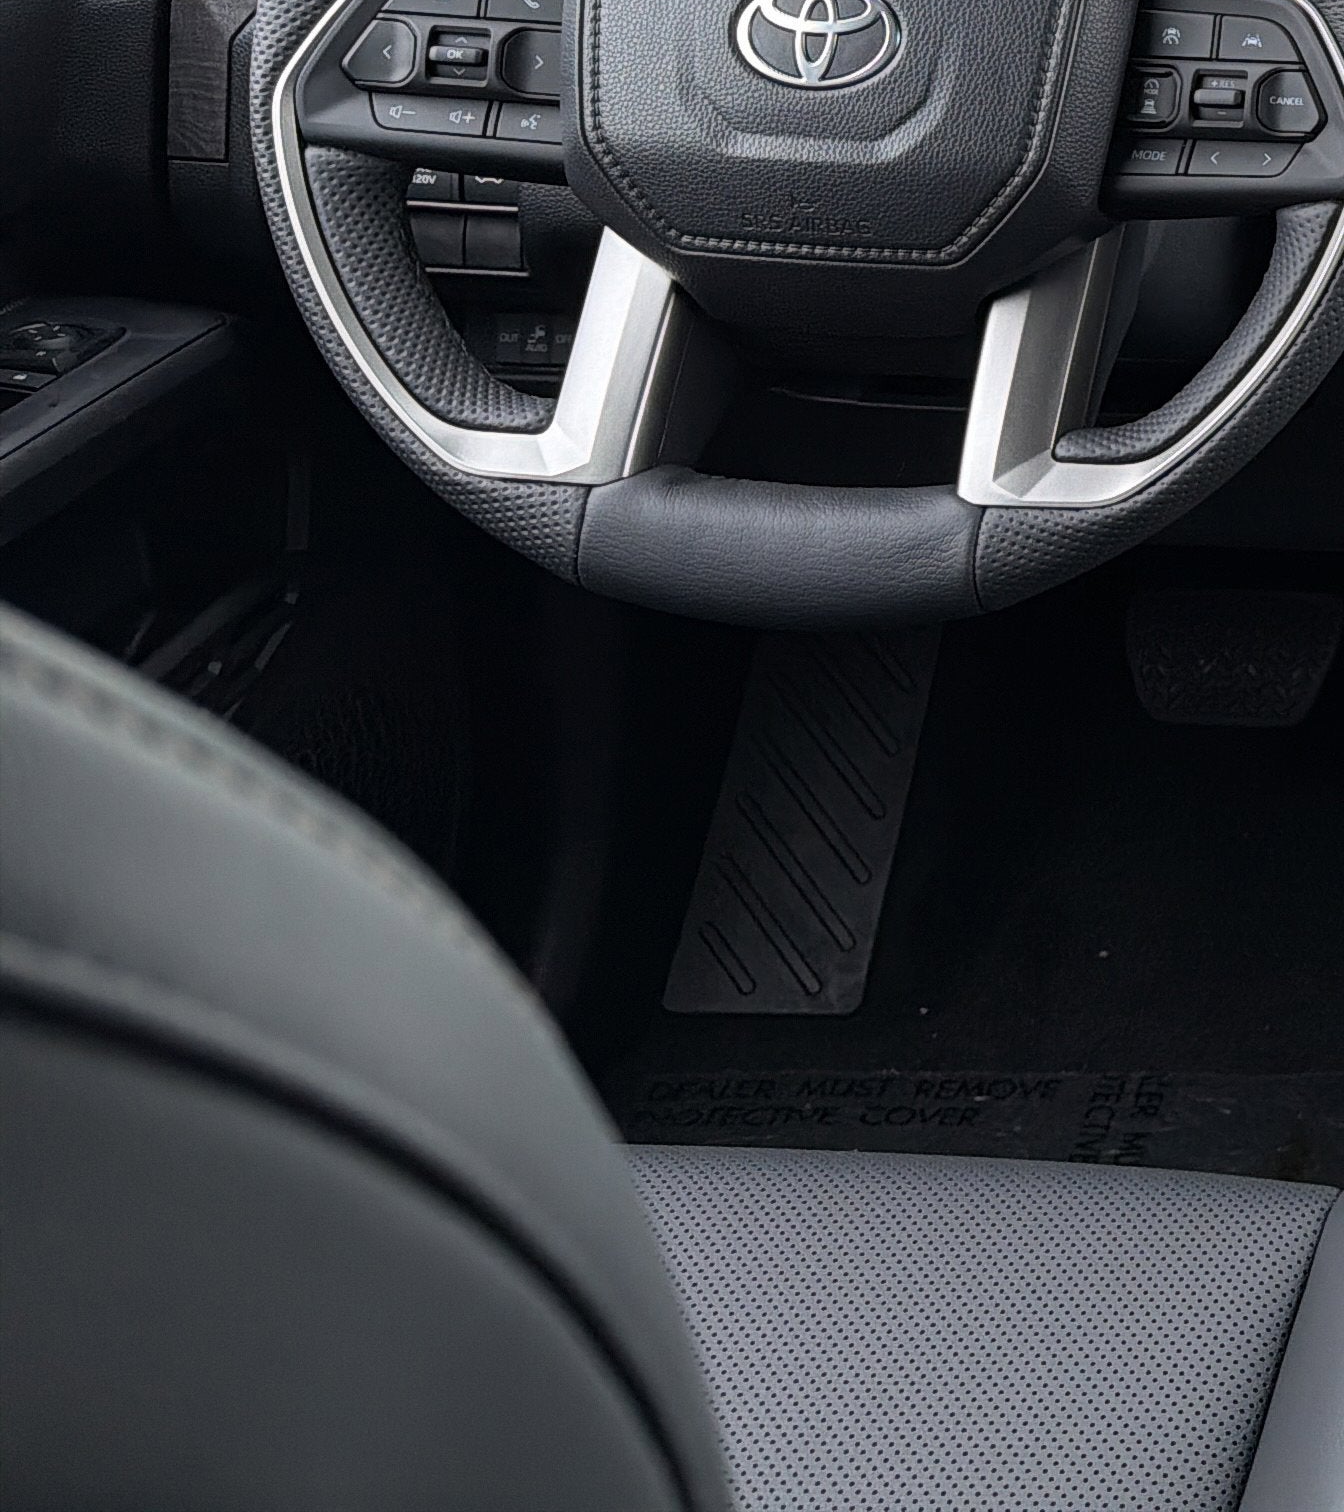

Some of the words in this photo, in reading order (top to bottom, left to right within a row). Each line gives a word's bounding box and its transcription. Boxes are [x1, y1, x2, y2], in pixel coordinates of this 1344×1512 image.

[446, 49, 464, 59] OK
[1269, 96, 1304, 106] CANCEL
[1131, 150, 1167, 161] MODE
[914, 1079, 1061, 1100] REMOVE
[860, 1105, 980, 1126] COVER
